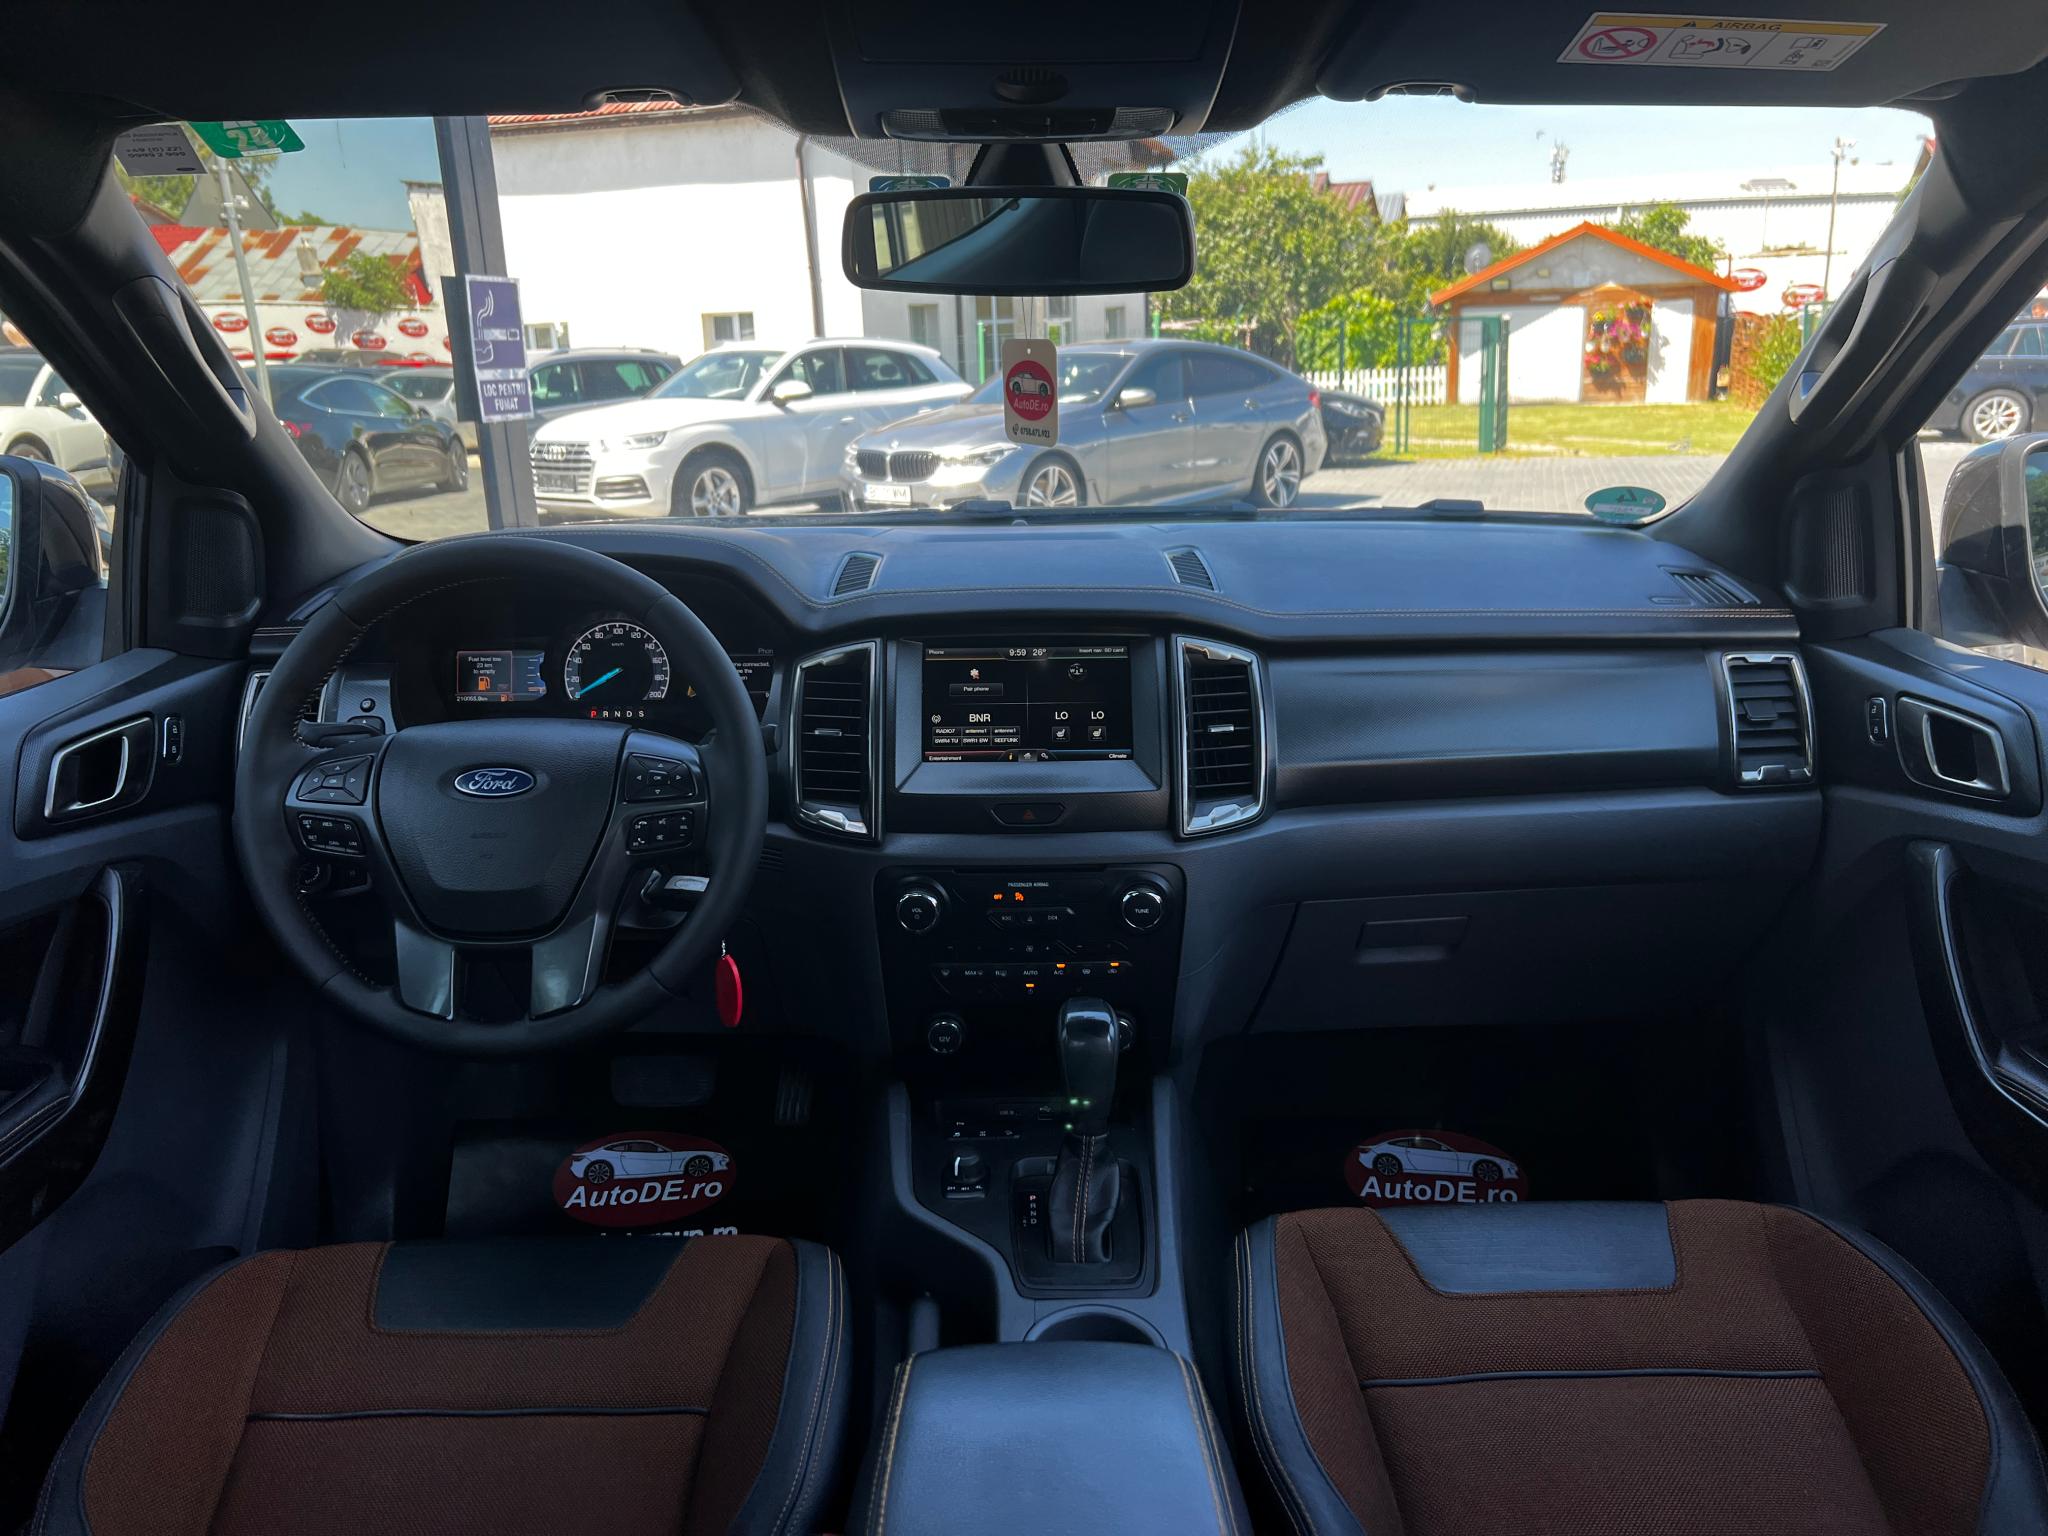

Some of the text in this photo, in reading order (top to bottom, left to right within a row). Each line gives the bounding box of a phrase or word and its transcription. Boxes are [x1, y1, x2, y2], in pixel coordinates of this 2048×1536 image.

[1710, 21, 1783, 32] AIRBAG
[483, 383, 526, 397] LOC PENTRU
[494, 398, 519, 411] FUMAT
[1013, 398, 1049, 412] AutoDE.ro
[1009, 648, 1027, 657] 9:59
[968, 713, 991, 723] BNR
[1055, 711, 1069, 720] LO
[1090, 710, 1105, 720] LO
[468, 771, 518, 790] Ford
[563, 1179, 723, 1209] AutoDE.ro
[1359, 1175, 1518, 1203] AutoDE.ro
